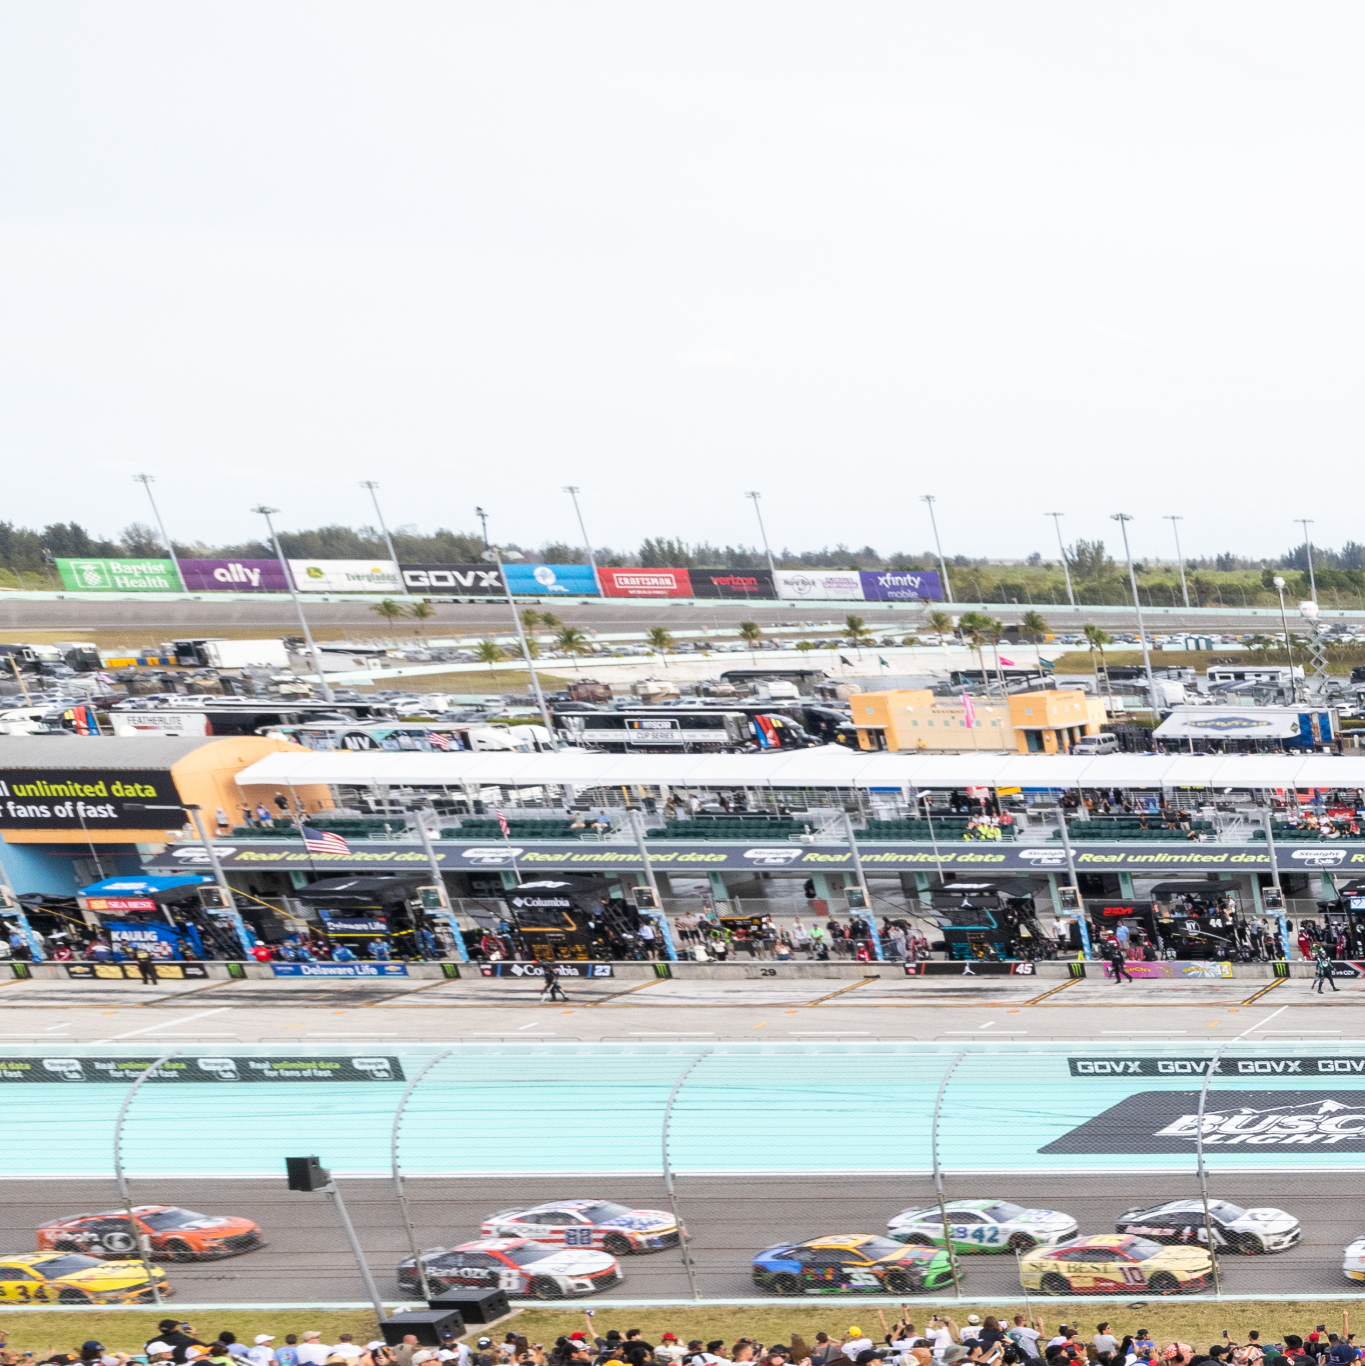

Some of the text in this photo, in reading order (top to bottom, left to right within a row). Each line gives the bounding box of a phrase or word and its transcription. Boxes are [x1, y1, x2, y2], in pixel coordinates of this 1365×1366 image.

[109, 561, 166, 576] Baptist
[214, 564, 260, 586] ally
[616, 575, 675, 587] CRAFTSMAN
[116, 576, 169, 589] Health
[877, 574, 921, 590] xfinity
[887, 589, 919, 599] mobile
[127, 716, 183, 726] FEATHERLITE
[12, 781, 157, 797] unlimited data
[7, 802, 119, 818] fans of fast
[108, 900, 153, 909] SEA BEST
[523, 896, 570, 907] Columbia
[112, 931, 158, 941] KAULIG
[301, 965, 378, 976] Delaware Life
[593, 965, 612, 975] 23
[760, 968, 776, 976] 29
[1015, 964, 1033, 974] 45
[1077, 1061, 1142, 1073] GOVX
[1210, 1135, 1358, 1144] LIGHT
[971, 1227, 999, 1242] 42
[499, 1269, 519, 1291] 8
[842, 1268, 879, 1286] 35
[1117, 1266, 1146, 1285] 10
